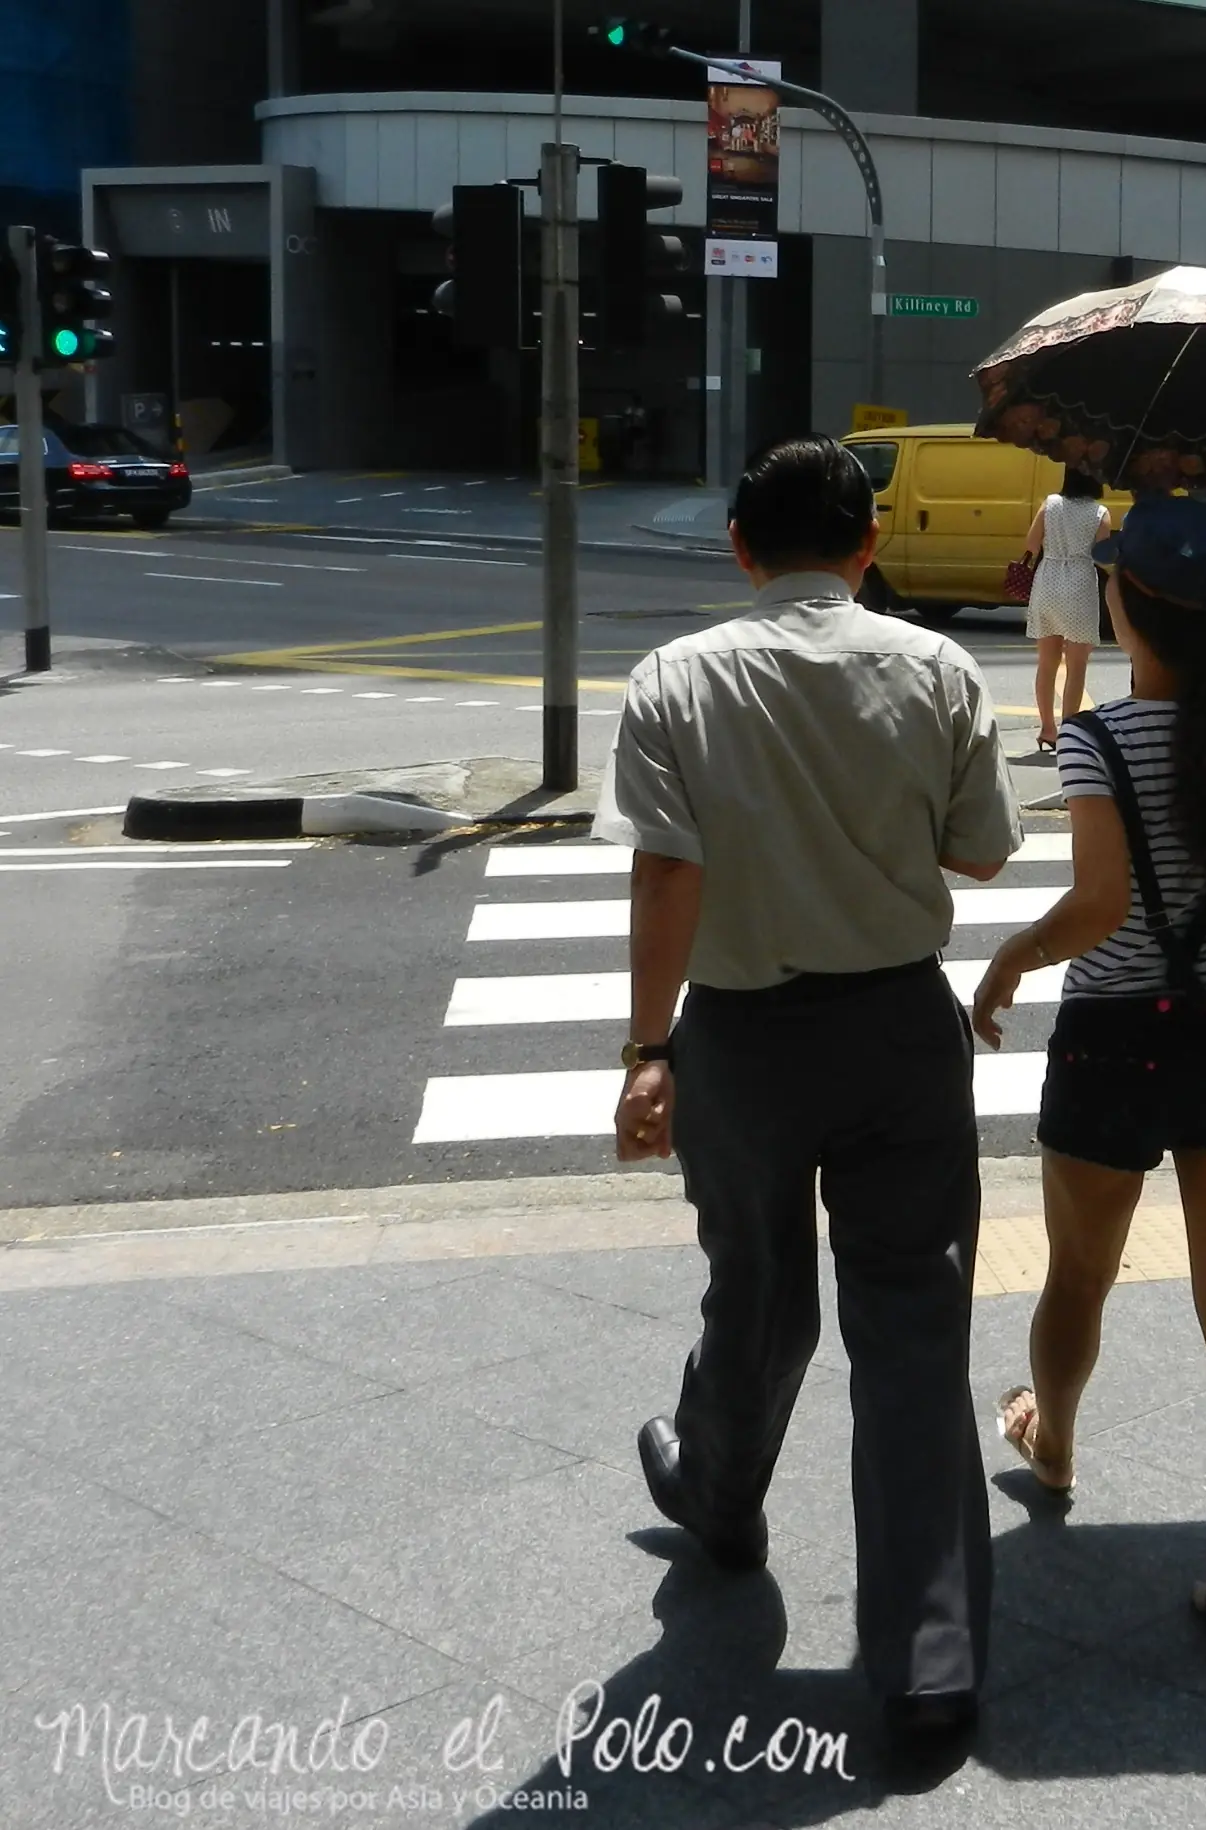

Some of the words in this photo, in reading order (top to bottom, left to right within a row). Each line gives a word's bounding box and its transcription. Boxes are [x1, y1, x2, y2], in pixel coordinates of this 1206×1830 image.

[207, 207, 233, 233] IN
[895, 297, 949, 316] Killiney
[955, 299, 972, 313] Rd
[134, 402, 146, 419] P
